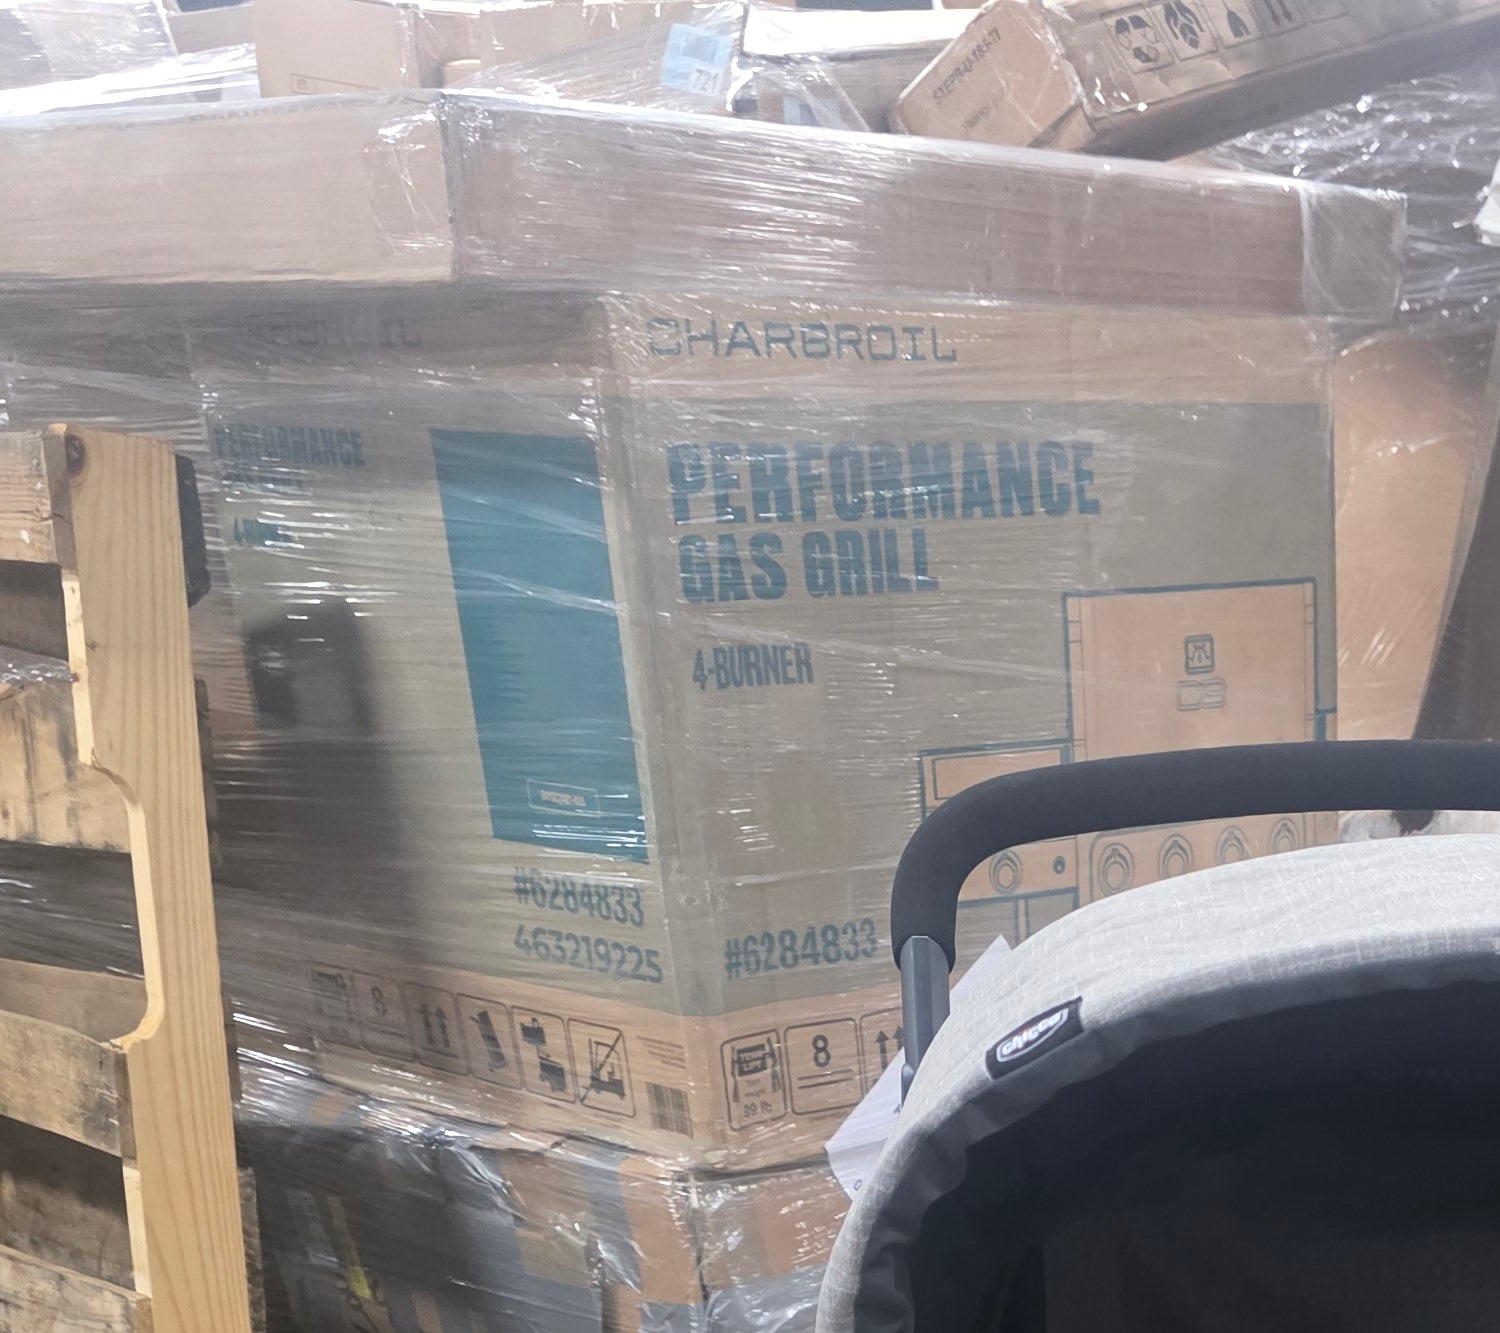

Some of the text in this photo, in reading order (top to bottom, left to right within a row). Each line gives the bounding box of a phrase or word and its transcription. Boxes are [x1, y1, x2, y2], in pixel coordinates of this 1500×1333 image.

[666, 440, 1101, 526] PERFORMANCE
[678, 527, 940, 603] GAS GRILL
[692, 641, 815, 692] 4-BURNER
[513, 866, 645, 928] #6284833
[514, 924, 663, 984] 463219225
[724, 917, 879, 980] #6284833
[812, 1033, 832, 1068] 8
